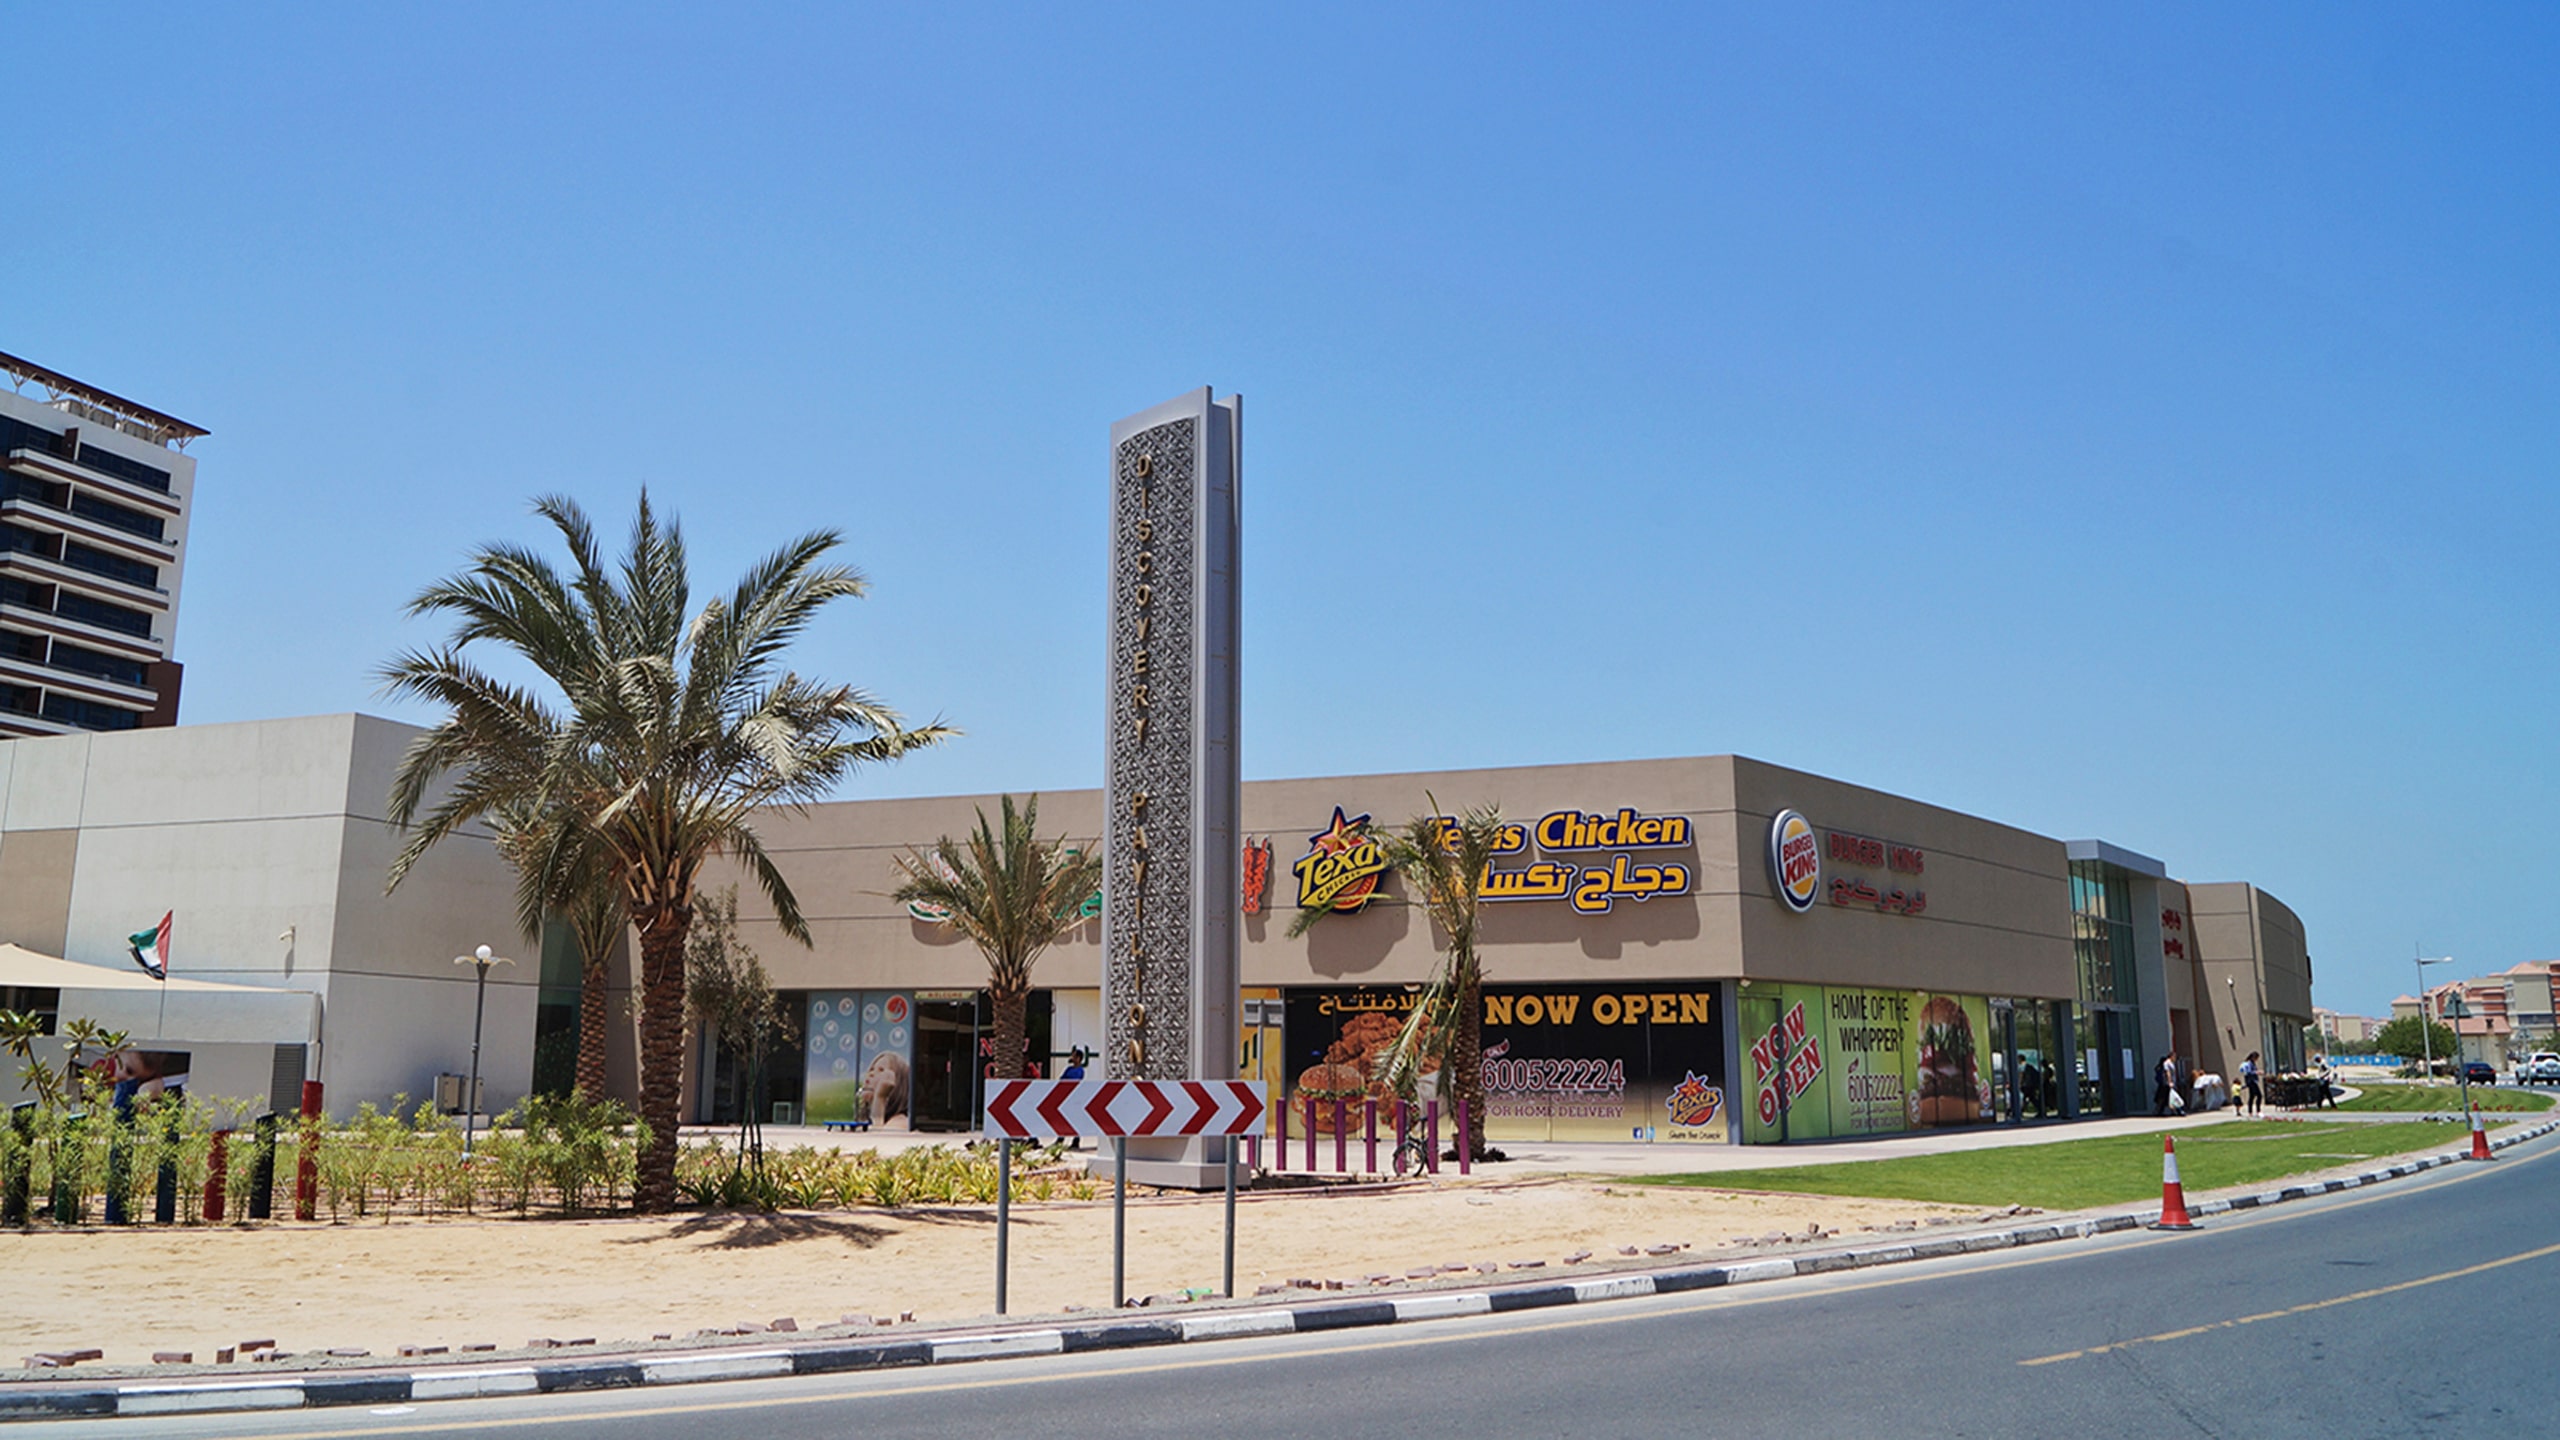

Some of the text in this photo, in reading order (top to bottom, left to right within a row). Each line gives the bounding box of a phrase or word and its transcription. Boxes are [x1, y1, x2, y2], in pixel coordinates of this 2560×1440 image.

[1129, 455, 1151, 1080] DISCOVERY PAVILION
[1537, 810, 1687, 848] Chicken
[1783, 834, 1814, 862] BURGER
[1830, 833, 1925, 874] BURGER KING
[1576, 857, 1686, 909] دجاج
[1785, 850, 1817, 886] KING
[1485, 995, 1580, 1025] NOW
[1592, 993, 1710, 1025] OPEN
[1831, 994, 1909, 1022] HOME OF THE
[1751, 1001, 1806, 1084] NOW
[1481, 1058, 1625, 1090] 600522224
[1759, 1038, 1822, 1125] OPEN
[1515, 1105, 1555, 1117] HOME
[1558, 1105, 1624, 1118] DELIVERY
[1668, 1089, 1719, 1119] Texas
